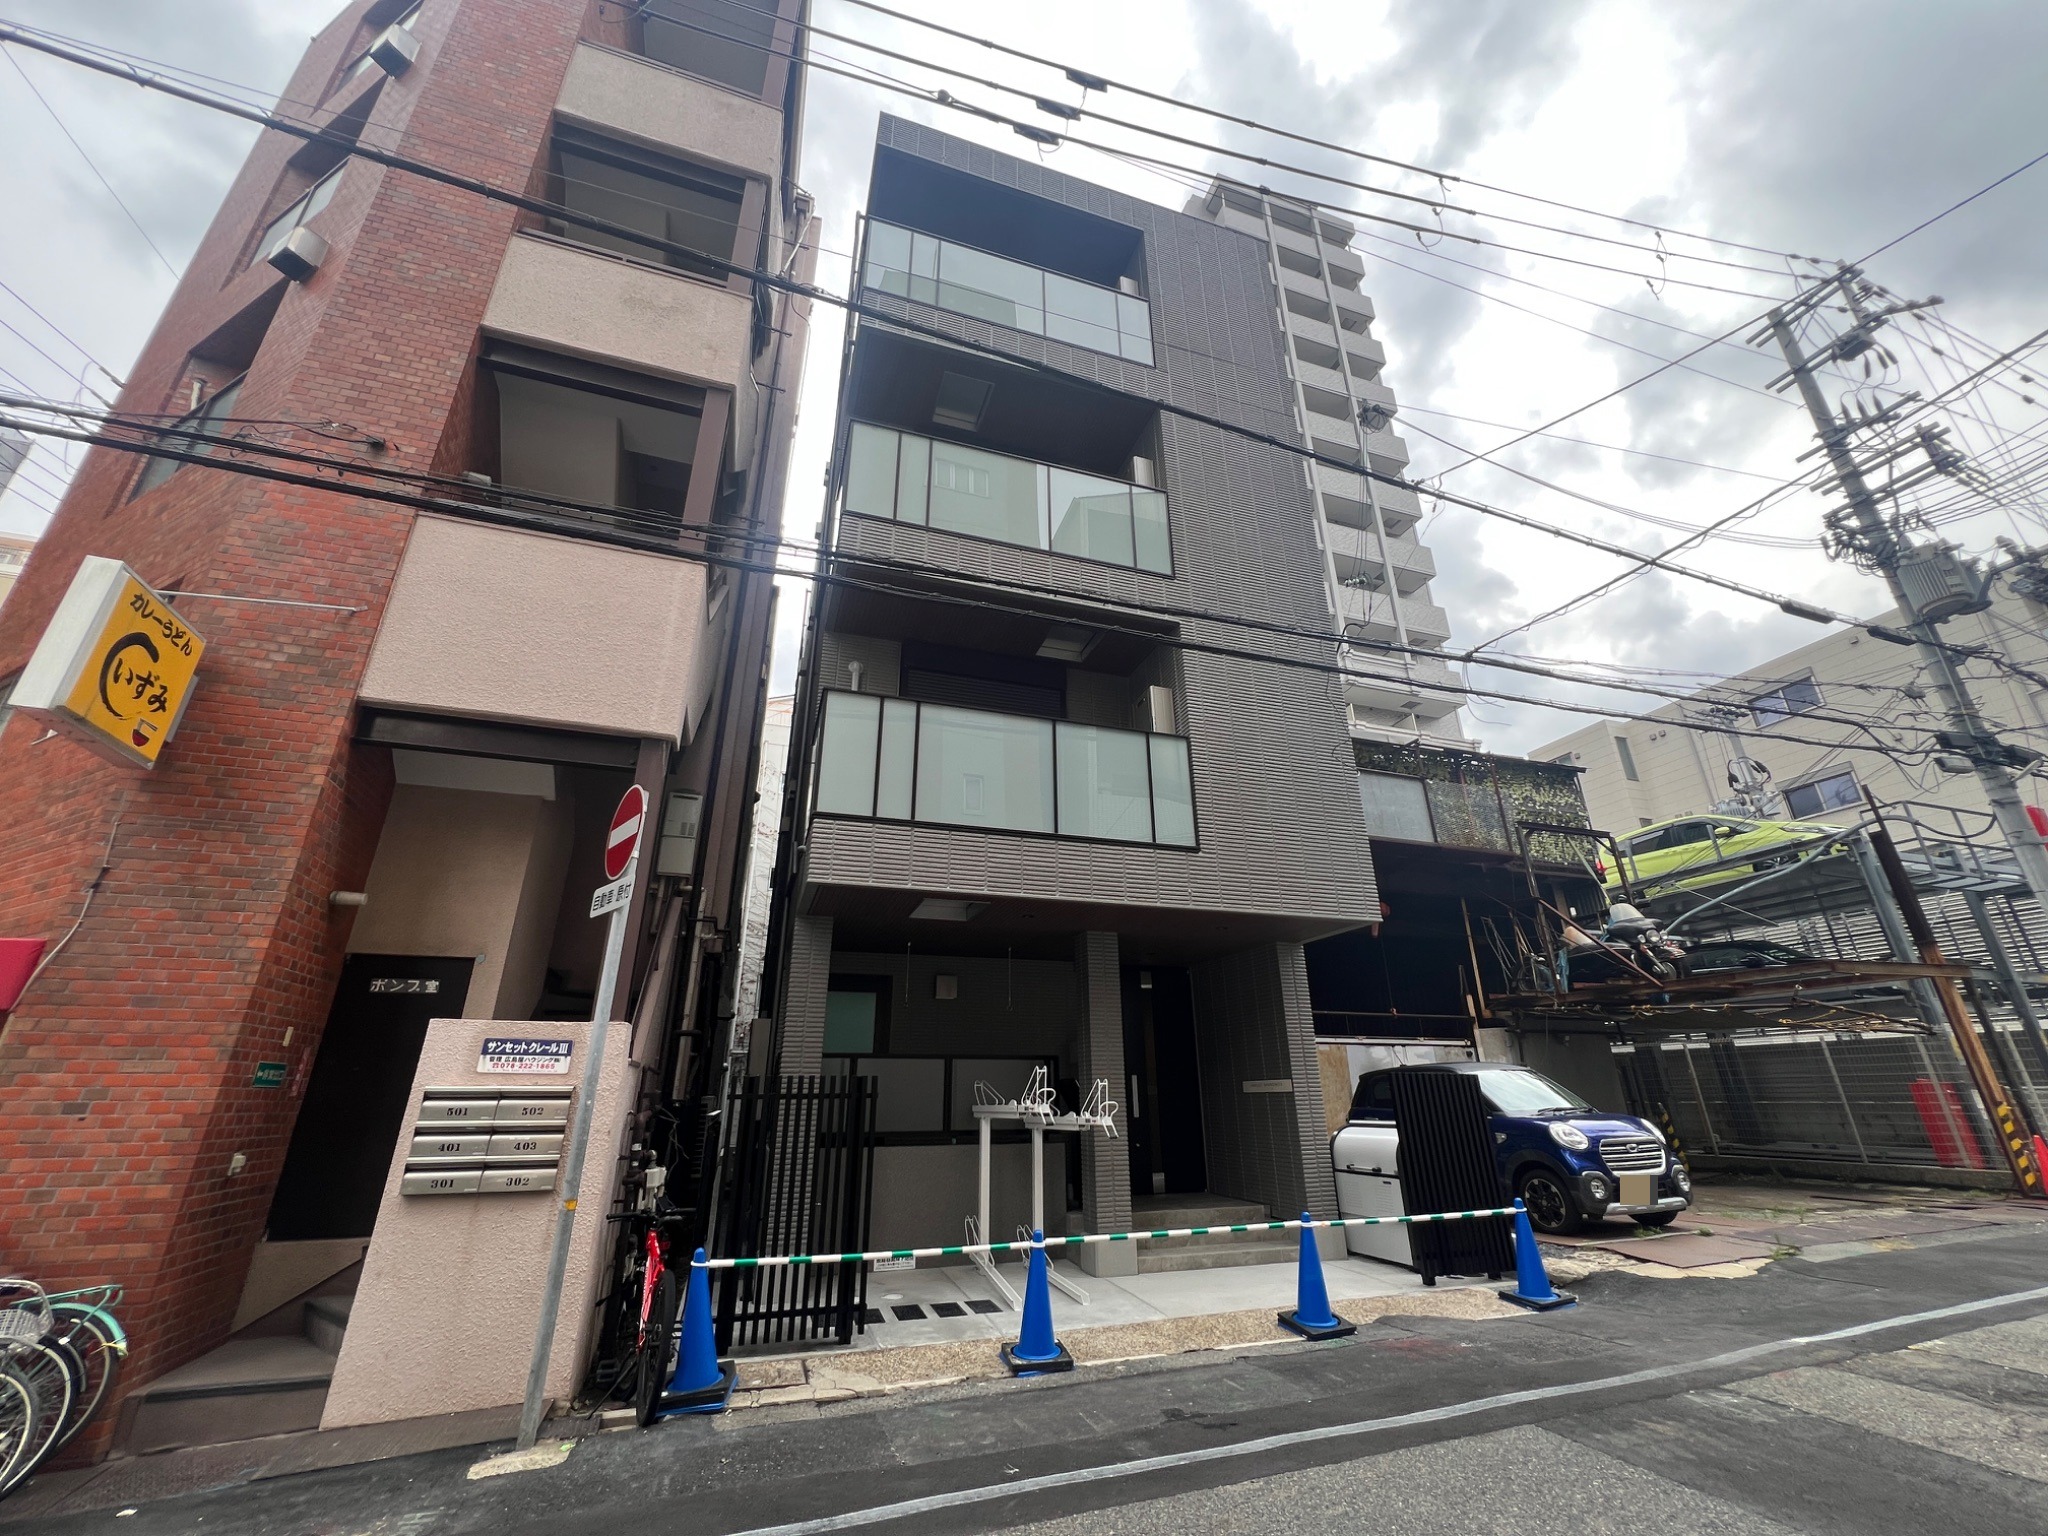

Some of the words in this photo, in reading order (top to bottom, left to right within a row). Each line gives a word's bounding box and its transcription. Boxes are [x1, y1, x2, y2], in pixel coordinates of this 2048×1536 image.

[130, 593, 193, 656] カレーうどん
[113, 658, 169, 712] いずみ
[446, 1107, 468, 1116] 501
[521, 1106, 544, 1116] 502
[438, 1142, 461, 1152] 401
[513, 1141, 537, 1151] 403
[430, 1179, 454, 1189] 301
[505, 1177, 530, 1187] 302
